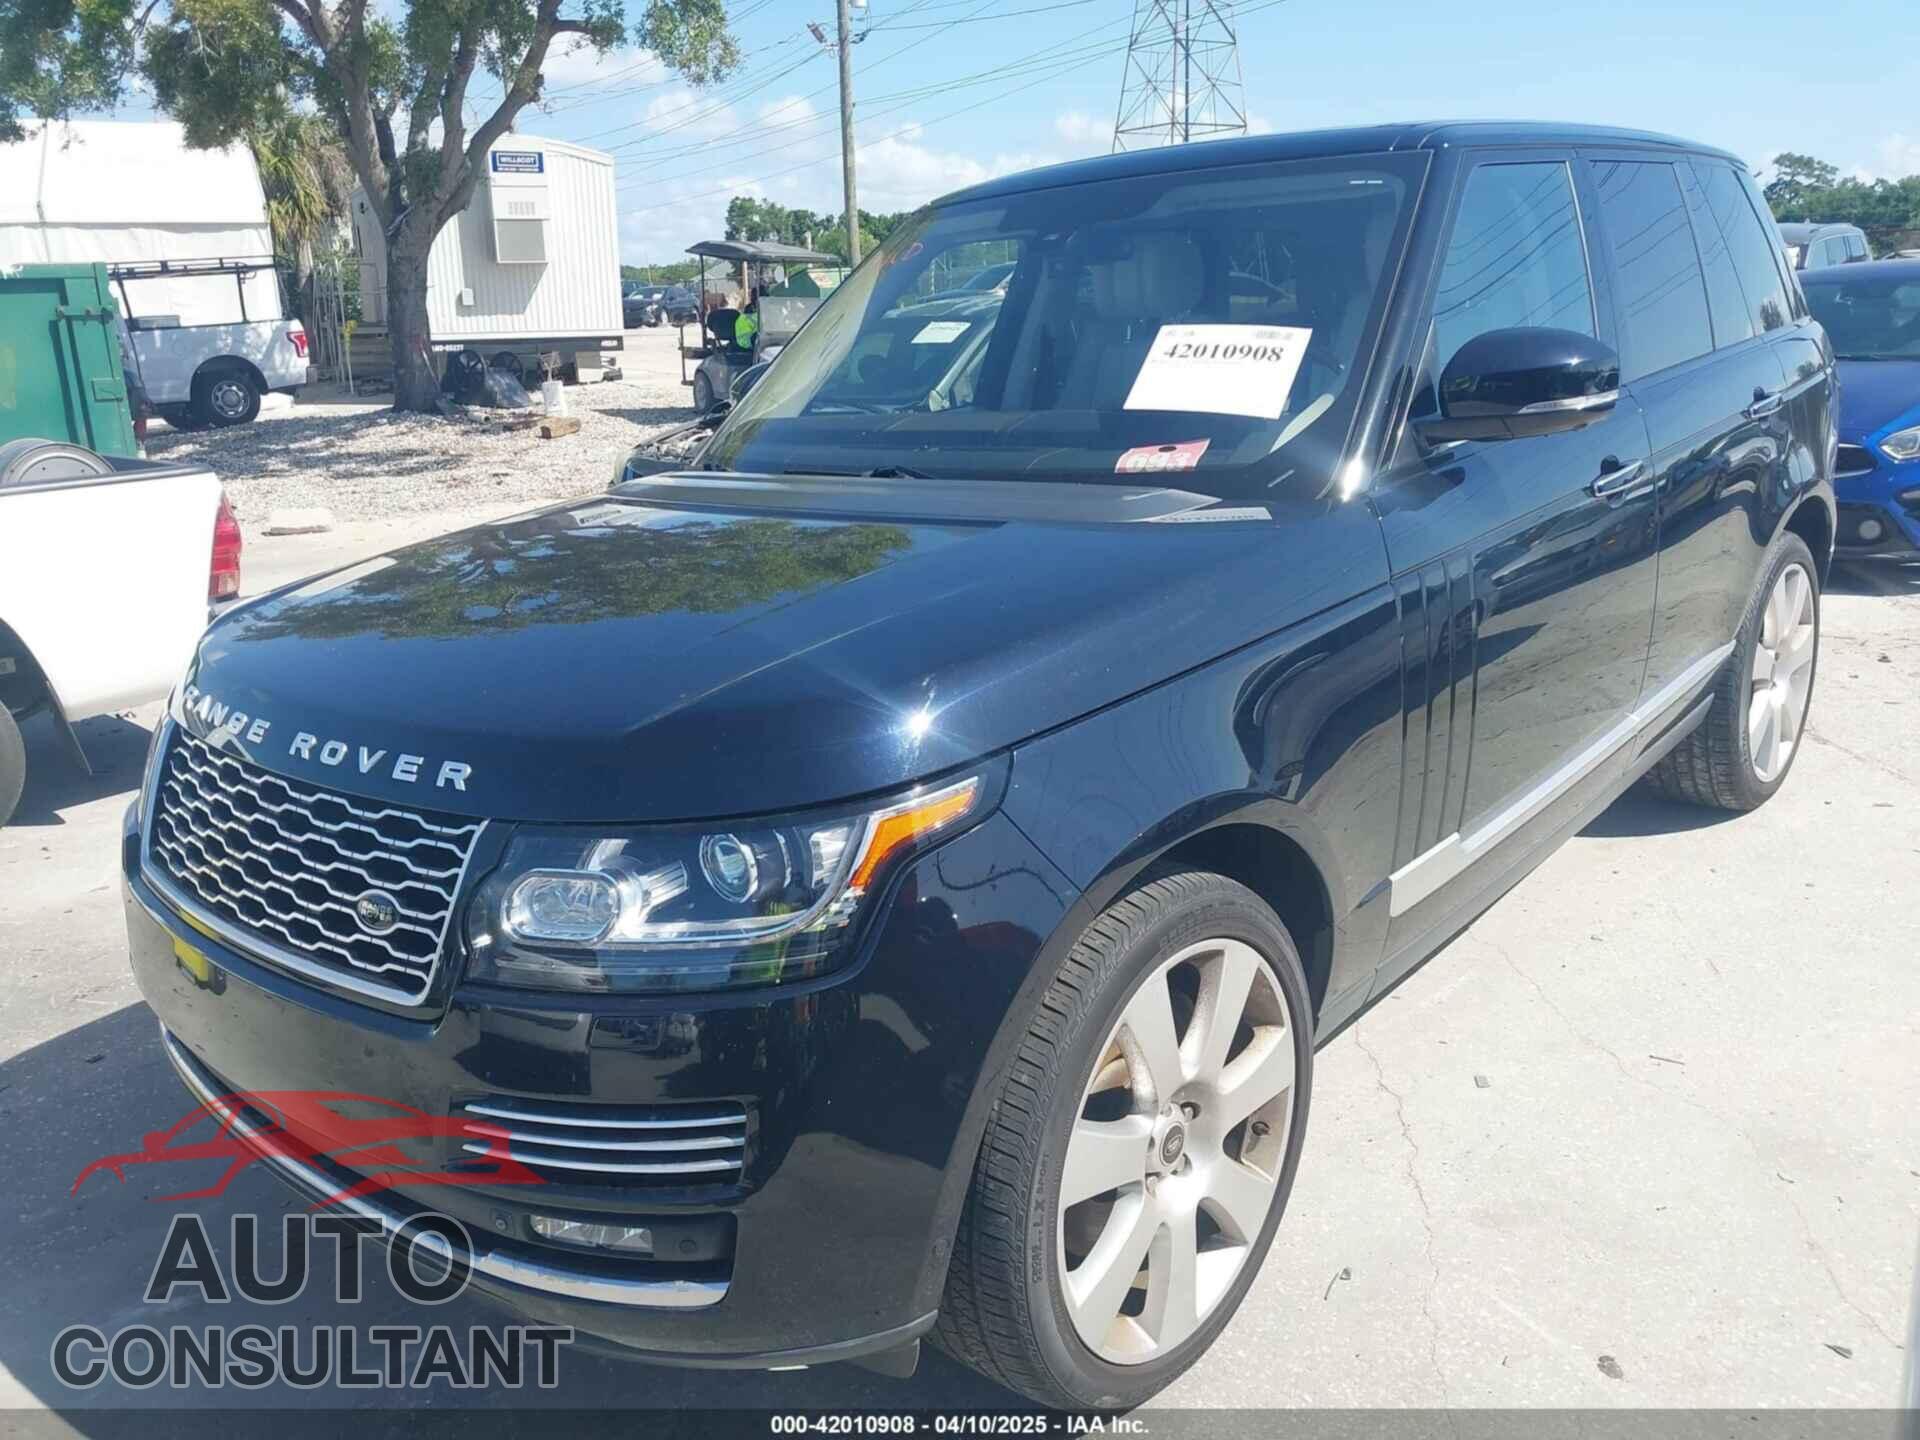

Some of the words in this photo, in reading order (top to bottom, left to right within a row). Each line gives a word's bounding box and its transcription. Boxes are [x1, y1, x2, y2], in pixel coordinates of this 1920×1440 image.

[1163, 343, 1284, 362] 42010908
[183, 684, 271, 744] RANGE
[289, 731, 472, 791] ROVER
